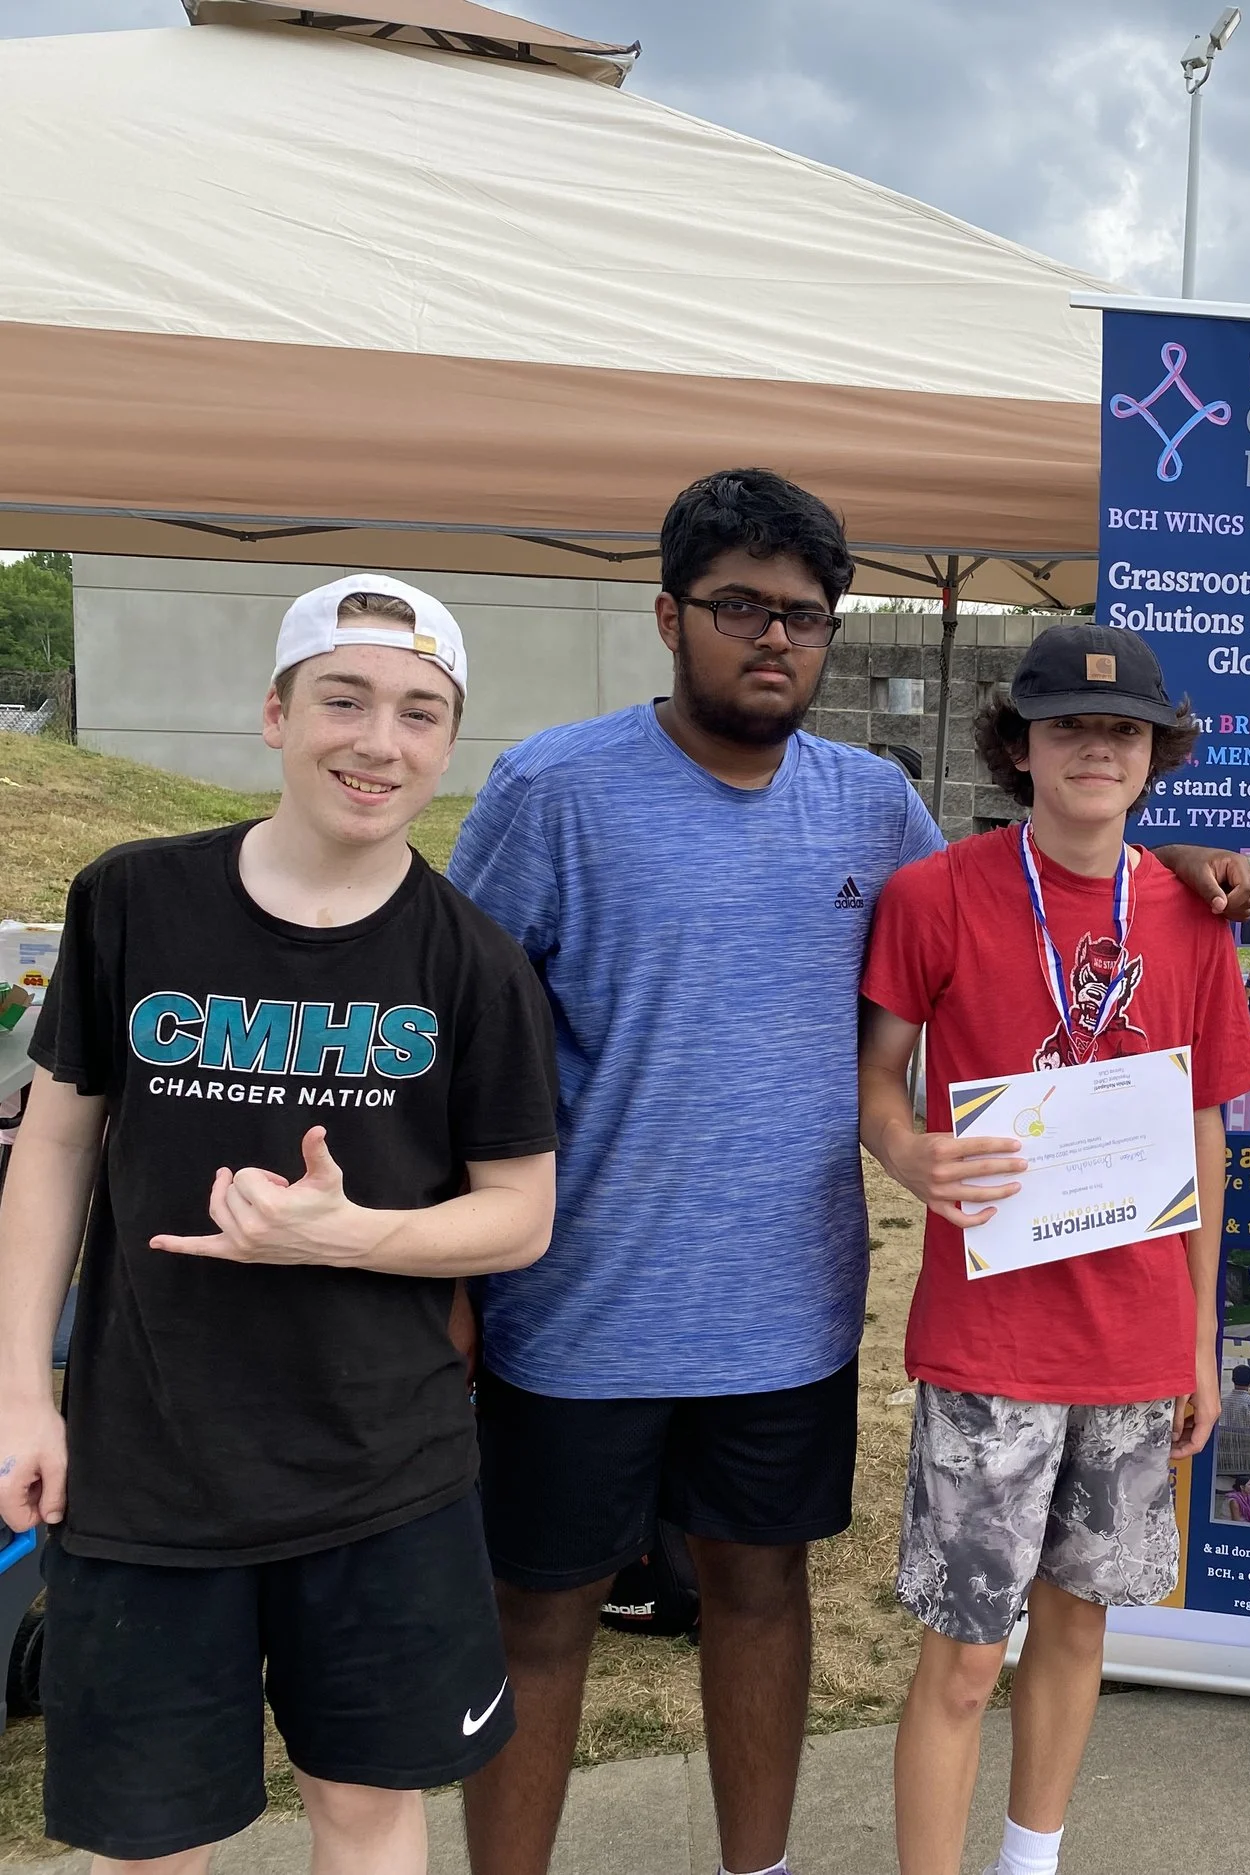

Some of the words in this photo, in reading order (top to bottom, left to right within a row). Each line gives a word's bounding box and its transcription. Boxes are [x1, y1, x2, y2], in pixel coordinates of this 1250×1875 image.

[1107, 507, 1158, 531] BCH
[1163, 511, 1245, 535] WINGS
[1109, 602, 1245, 635] Solutions
[1173, 777, 1232, 797] stand
[1137, 807, 1181, 826] ALL
[129, 991, 439, 1079] CMHS
[149, 1076, 286, 1106] CHARGER
[298, 1087, 397, 1108] NATION
[1032, 1204, 1137, 1242] CERTIFICATE
[1225, 1218, 1240, 1234] &
[1203, 1543, 1213, 1554] &
[1215, 1544, 1229, 1555] all
[1207, 1566, 1235, 1580] BCH,
[1238, 1572, 1244, 1580] a
